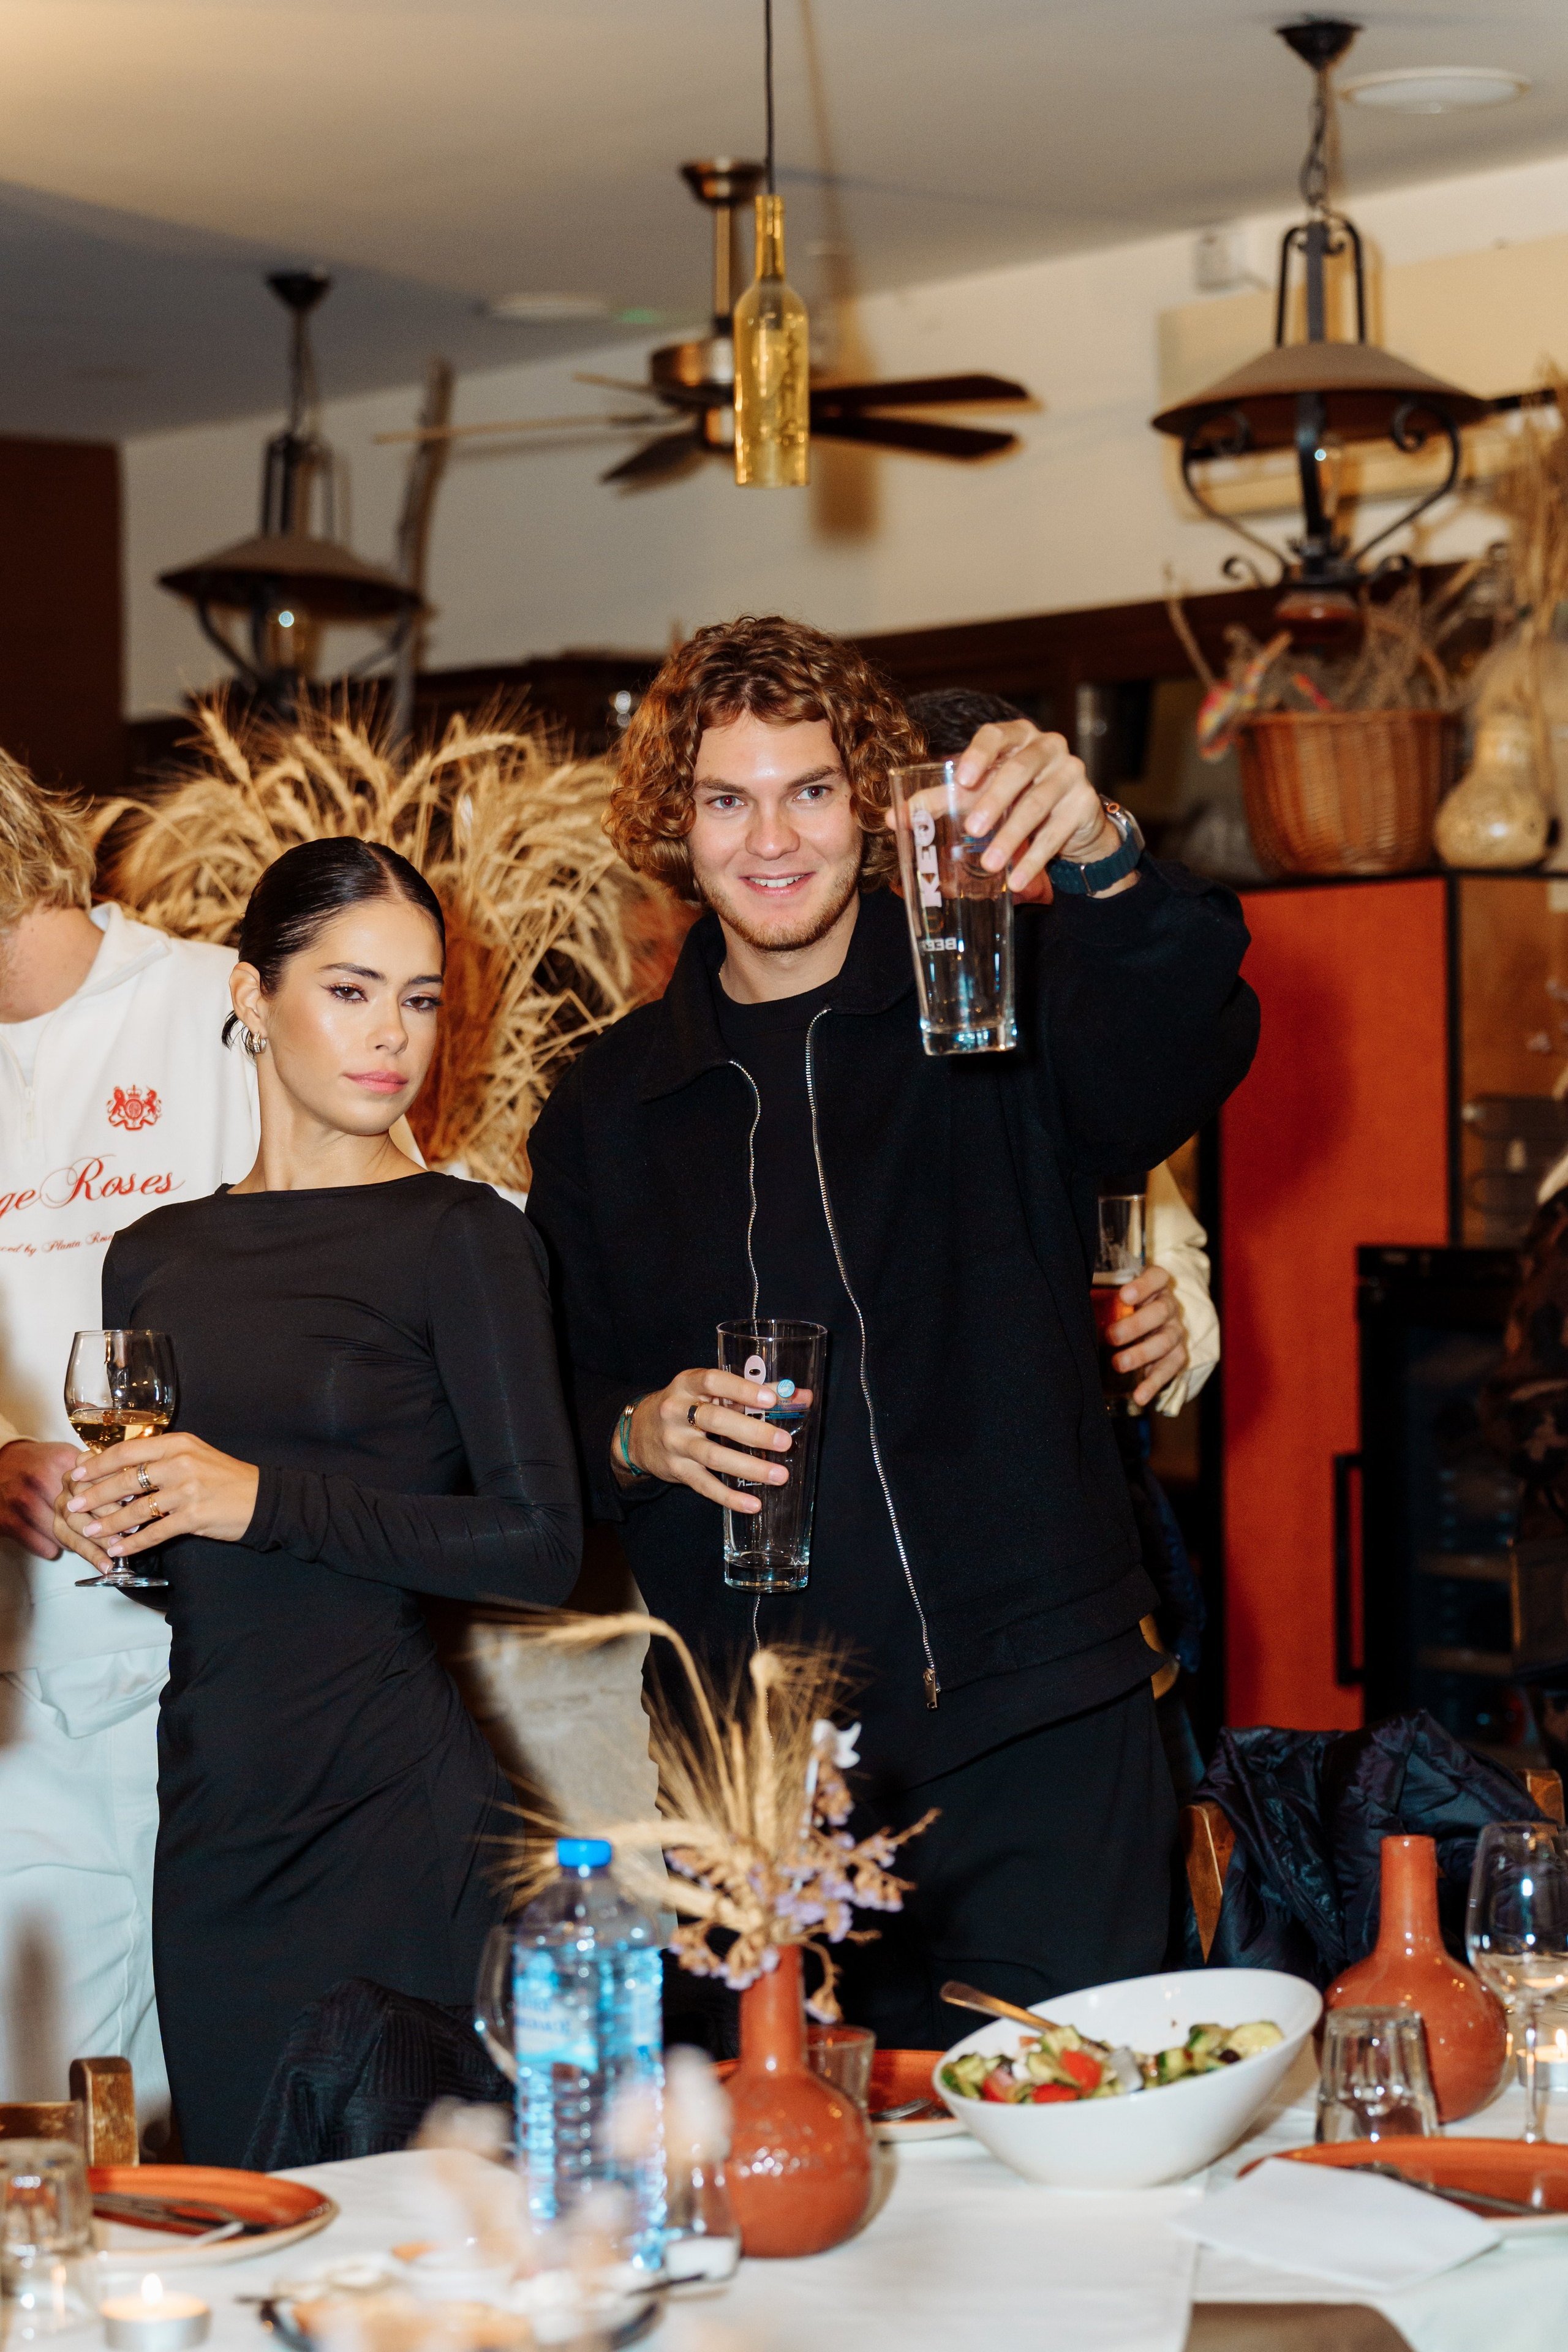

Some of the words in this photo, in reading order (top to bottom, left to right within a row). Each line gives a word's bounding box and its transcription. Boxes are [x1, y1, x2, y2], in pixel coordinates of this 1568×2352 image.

[913, 810, 942, 907] KEO
[40, 1154, 186, 1208] Roses
[24, 1243, 37, 1257] by
[42, 1238, 81, 1253] Planta
